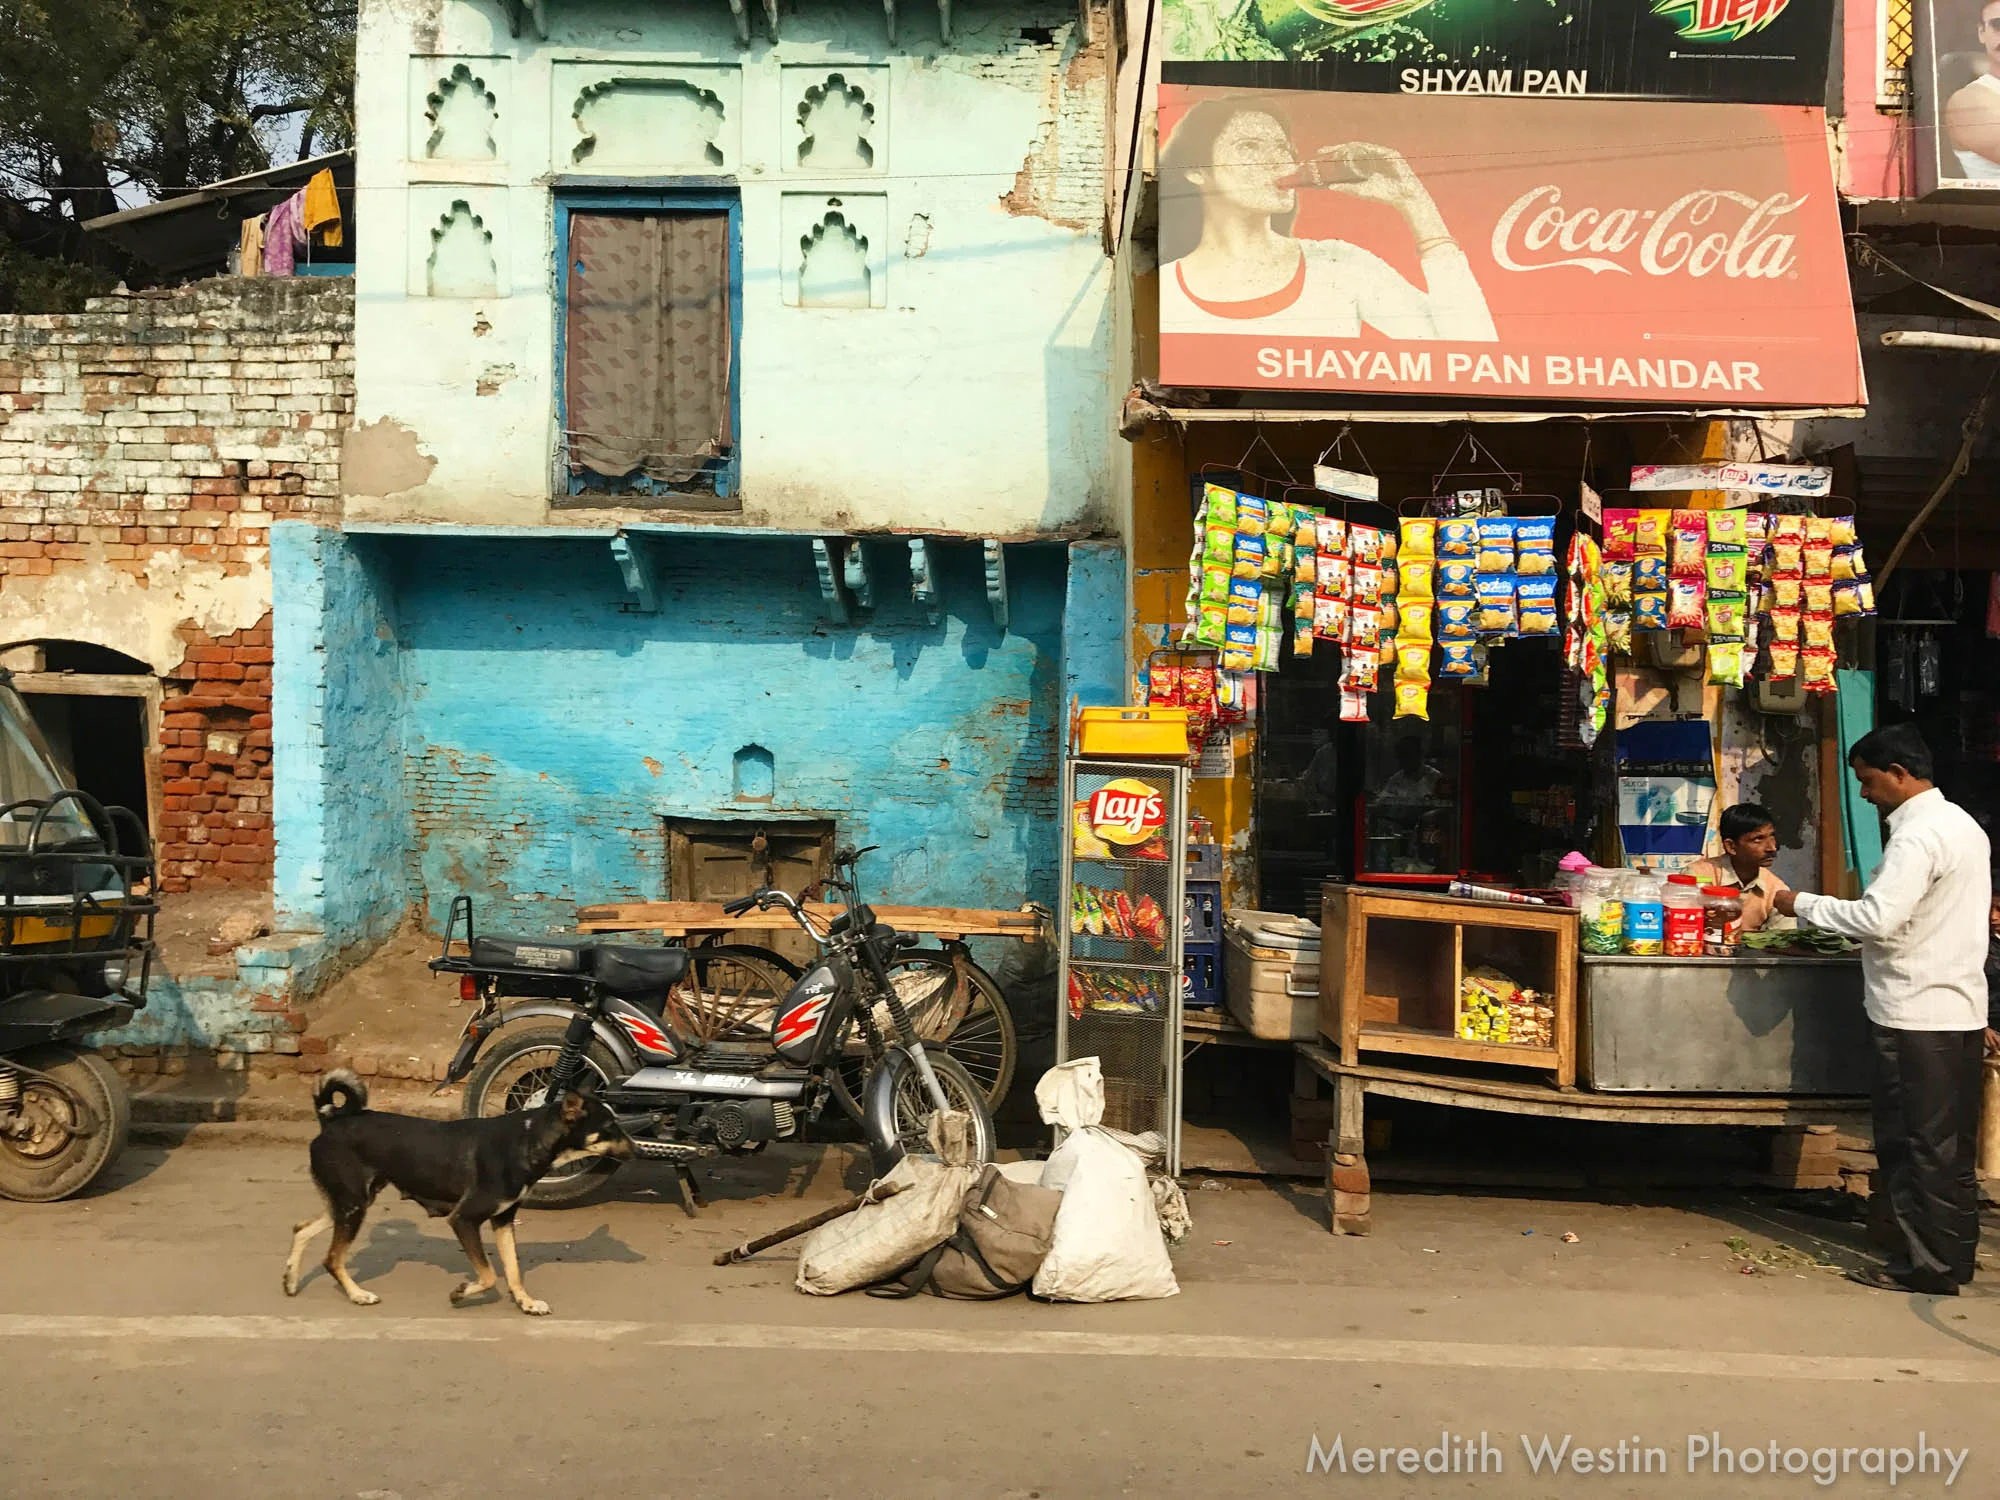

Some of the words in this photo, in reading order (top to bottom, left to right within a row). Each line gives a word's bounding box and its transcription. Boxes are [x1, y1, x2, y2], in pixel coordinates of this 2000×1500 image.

[1400, 68, 1513, 94] SHYAM
[1522, 69, 1588, 95] PAN
[1491, 184, 1810, 279] Coca-Cola
[1257, 347, 1432, 382] SHAYAM
[1447, 352, 1530, 384] PAN
[1546, 355, 1764, 391] BHANDAR
[1093, 791, 1163, 834] Lay's
